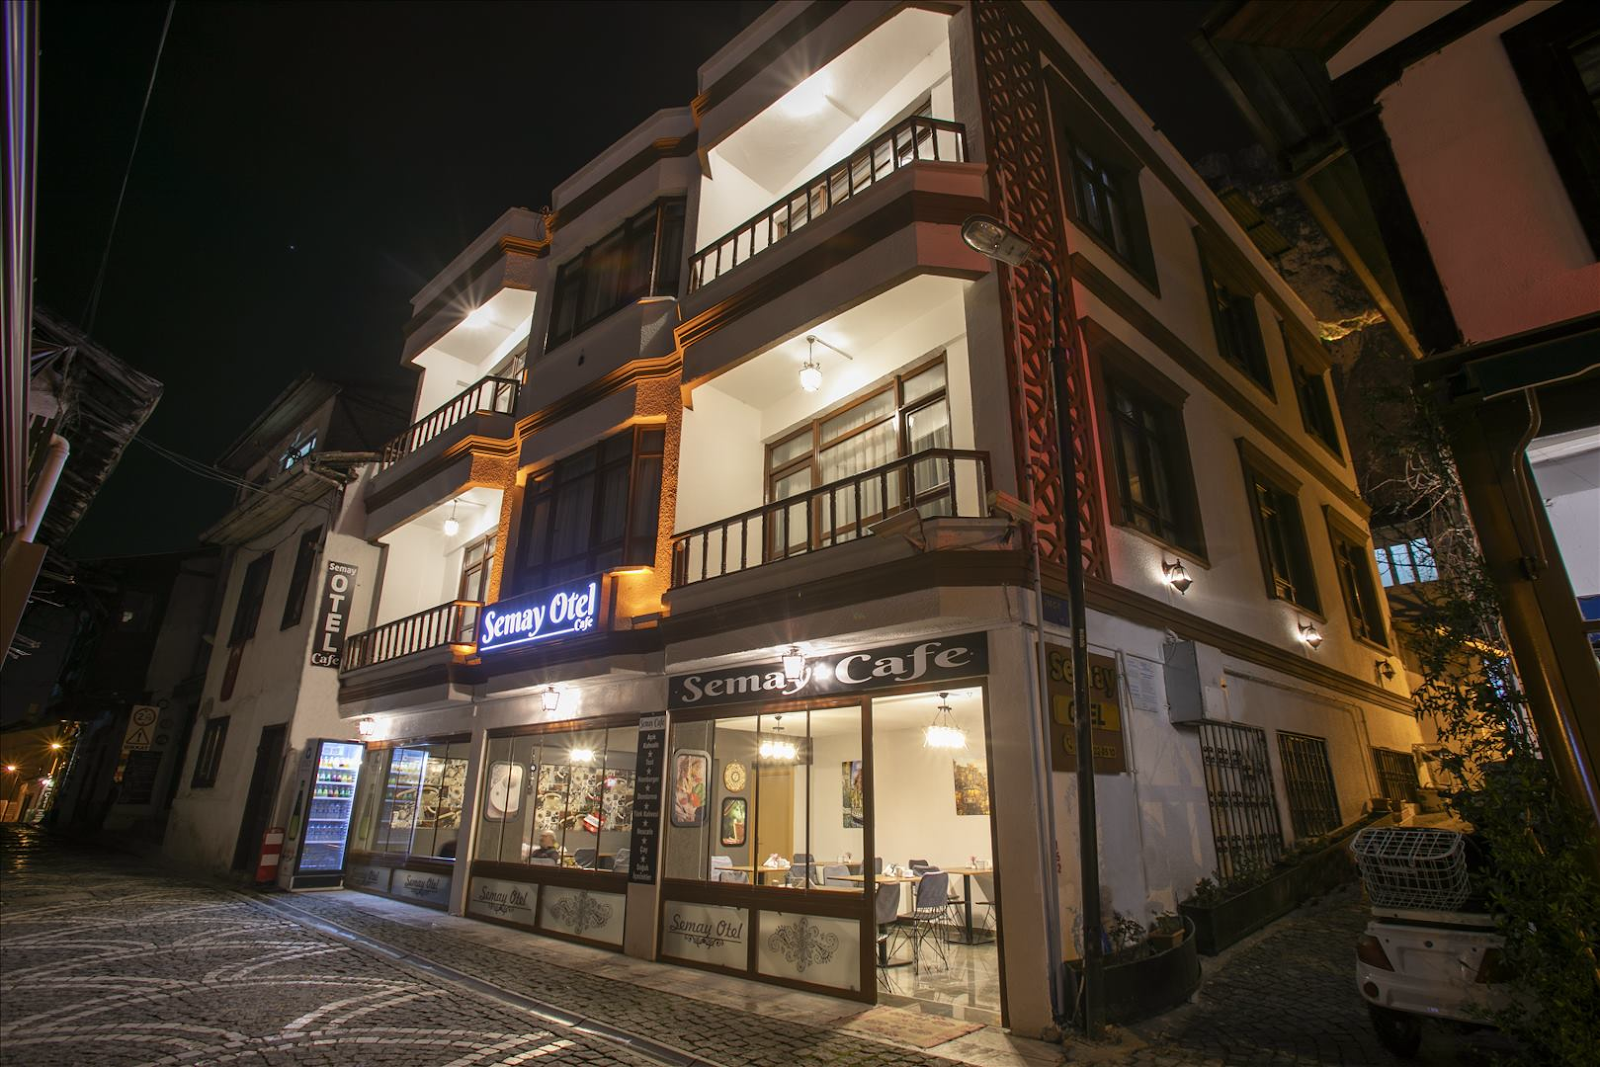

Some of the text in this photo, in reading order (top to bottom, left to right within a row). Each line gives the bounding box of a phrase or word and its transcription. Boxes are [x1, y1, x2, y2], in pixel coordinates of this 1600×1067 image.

[329, 562, 357, 576] Semay
[323, 574, 349, 652] OTEL
[482, 582, 597, 644] Semay Otel
[574, 616, 593, 631] Cafe
[311, 652, 340, 667] Cafe
[682, 642, 971, 703] Semay Cafe
[479, 886, 528, 906] Semay Otel
[669, 913, 743, 939] Semay Otel
